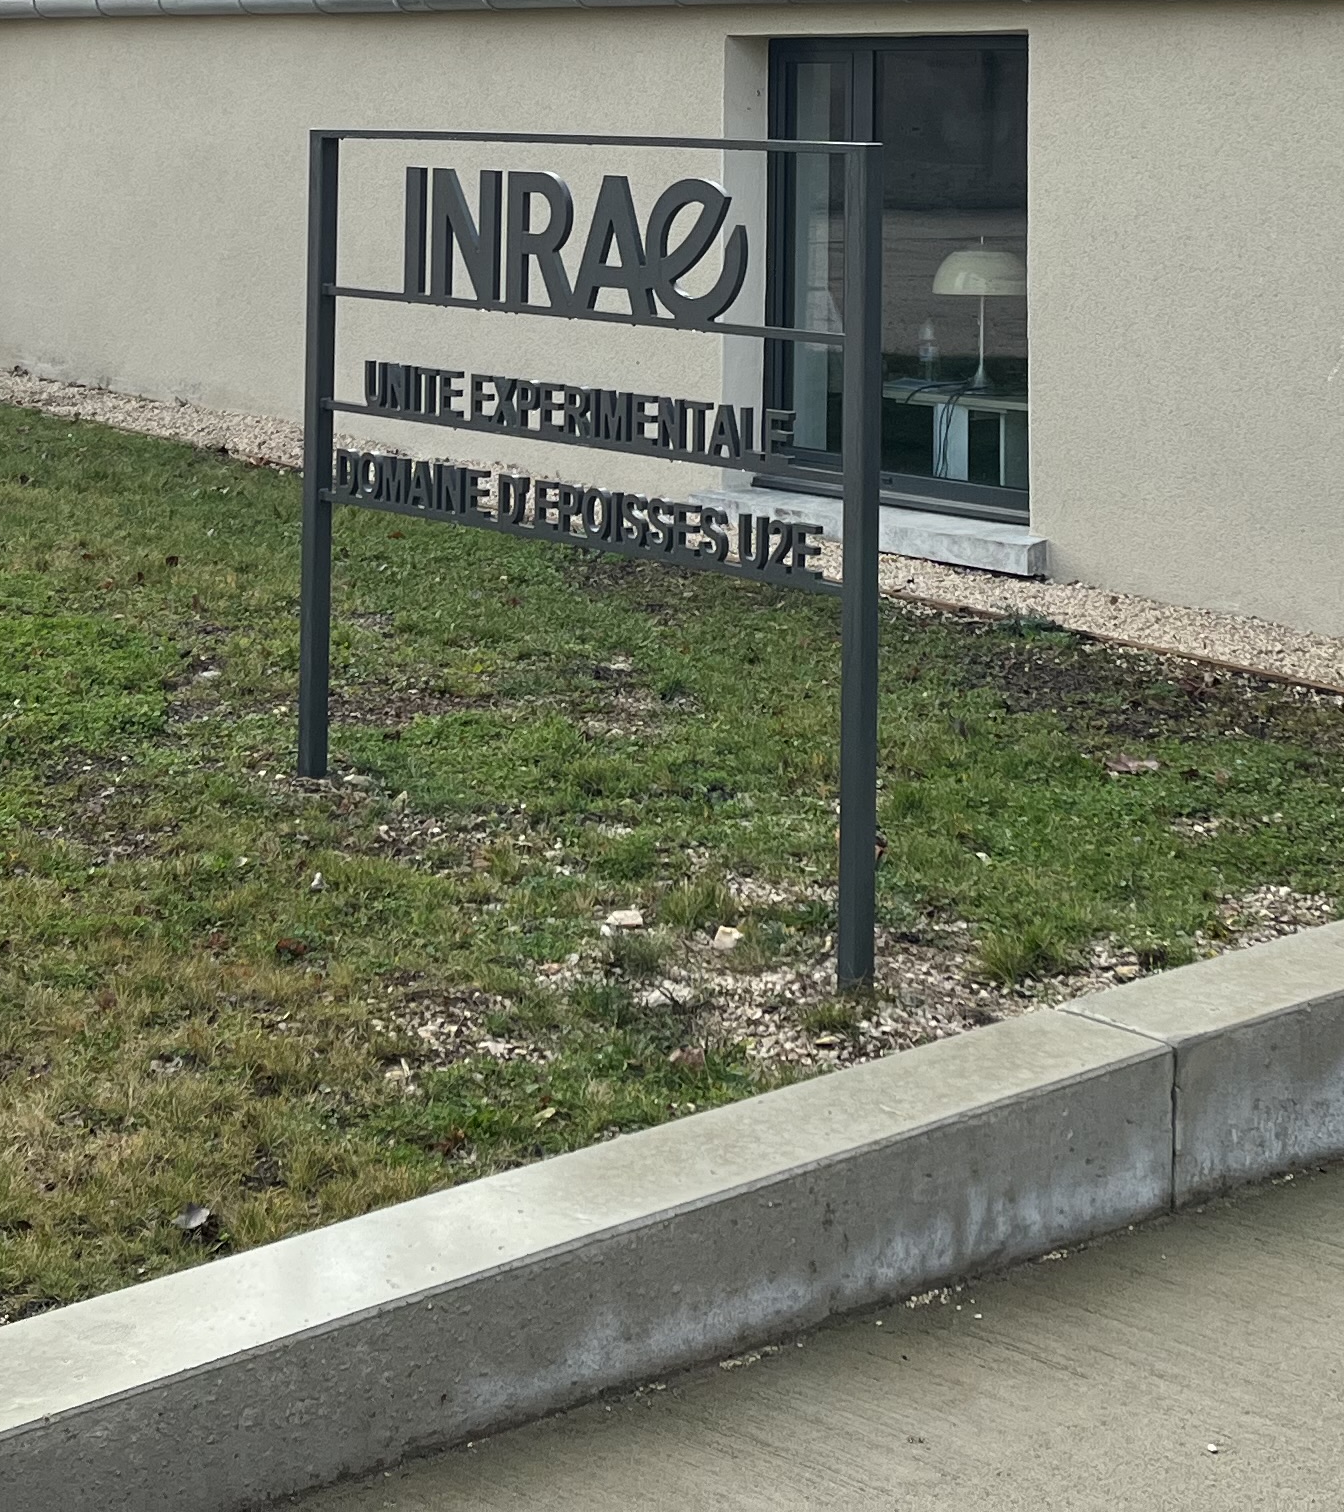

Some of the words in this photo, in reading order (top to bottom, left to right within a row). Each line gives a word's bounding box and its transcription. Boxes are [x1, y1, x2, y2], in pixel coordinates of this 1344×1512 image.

[365, 360, 464, 421] UNITE
[471, 373, 796, 466] EXPERIMENTALE
[336, 448, 492, 519] DOMAINE
[738, 513, 824, 581] U2E
